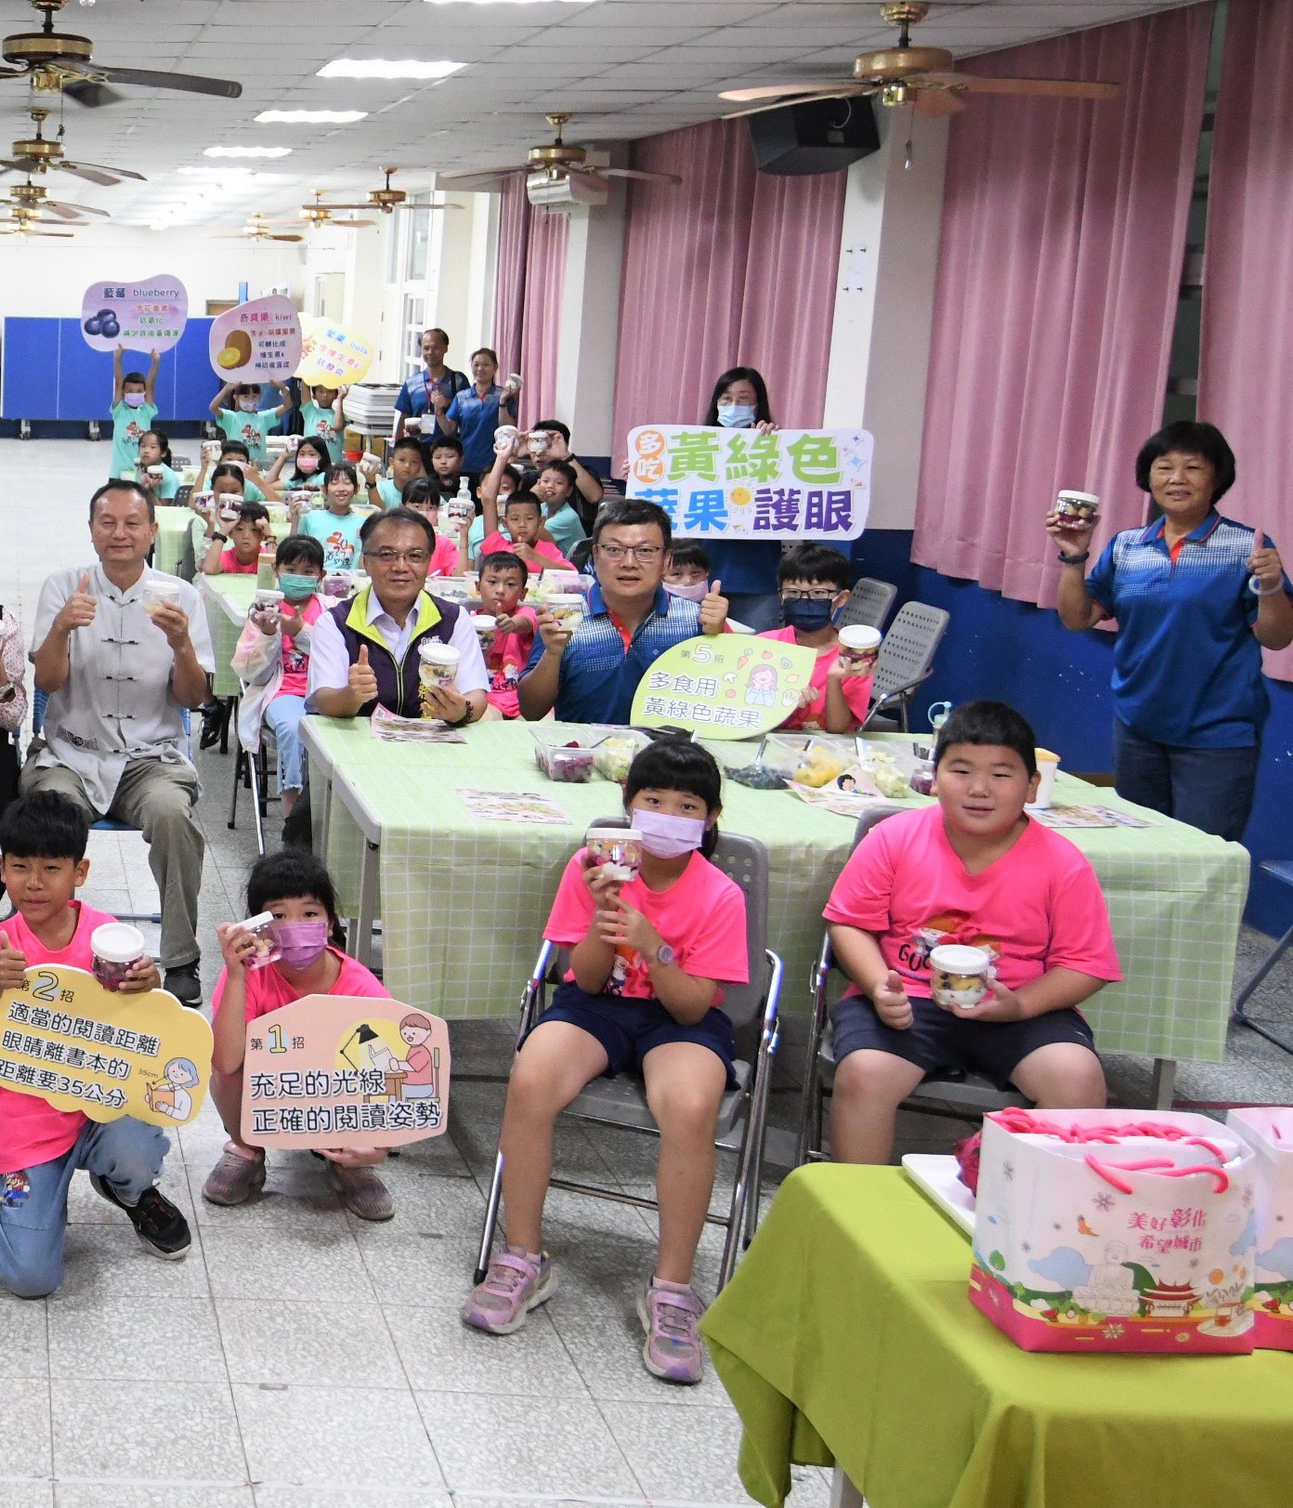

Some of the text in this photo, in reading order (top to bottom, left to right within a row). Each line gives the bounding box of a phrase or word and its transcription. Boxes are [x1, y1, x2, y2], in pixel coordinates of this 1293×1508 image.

[104, 288, 179, 298] 藍莓 blueberry
[240, 312, 292, 322] 奇異果 kiwi
[350, 342, 369, 355] nuts
[636, 431, 665, 481] 多吃
[667, 431, 843, 484] 黃綠色
[753, 488, 853, 532] 護眼
[680, 644, 724, 663] 第5招
[649, 671, 717, 697] 多食用
[643, 697, 761, 728] 黃綠色蔬果
[19, 971, 74, 1003] 第2招
[9, 1001, 159, 1055] 適當的閱讀距離
[250, 1024, 305, 1053] 第1招
[2, 1031, 130, 1078] 眼睛離書本的
[138, 1067, 159, 1078] 35cm
[250, 1069, 385, 1097] 充足的光線
[252, 1102, 441, 1132] 正確的閱讀姿勢
[1127, 1207, 1206, 1231] 美好彰化
[1140, 1234, 1202, 1254] 希望城市
